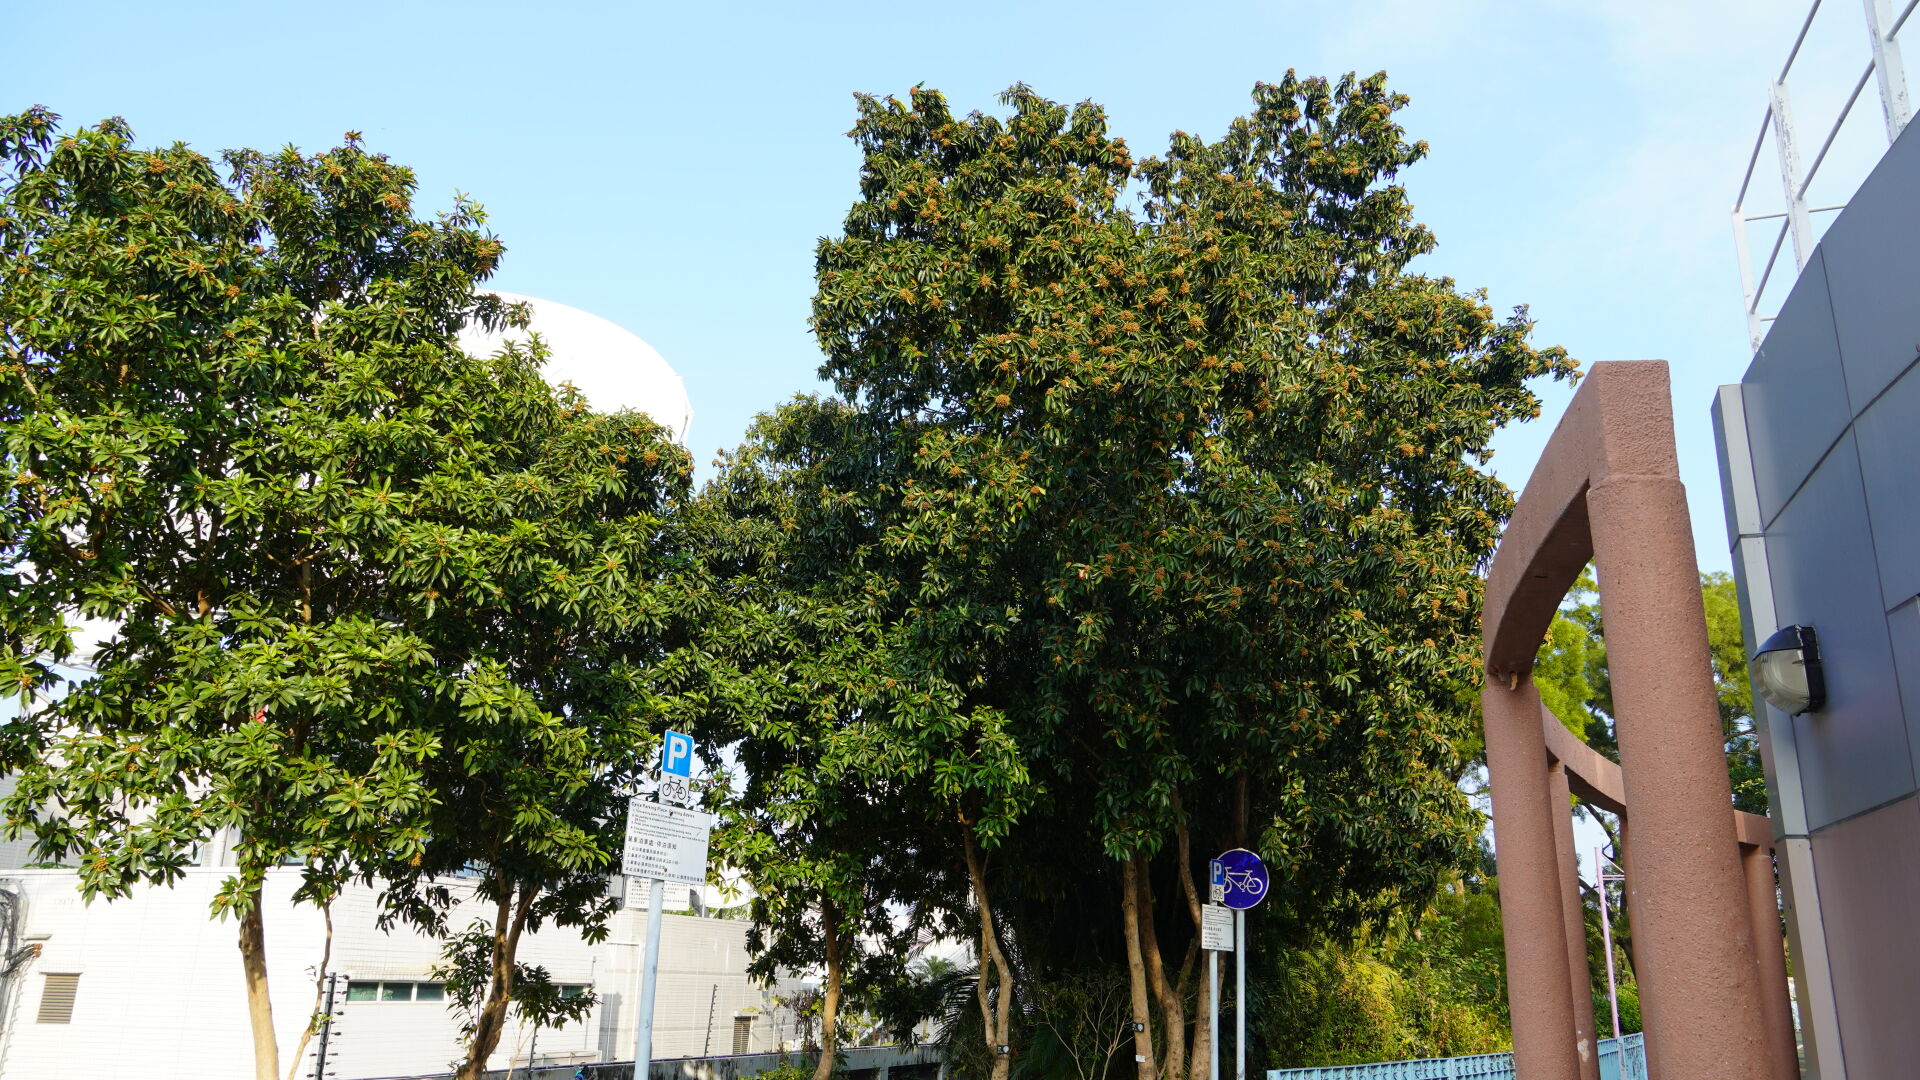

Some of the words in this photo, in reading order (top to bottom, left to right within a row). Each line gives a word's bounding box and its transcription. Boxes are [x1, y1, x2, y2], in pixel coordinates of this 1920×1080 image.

[667, 735, 688, 770] P
[642, 803, 657, 812] Parking
[1213, 861, 1222, 883] P
